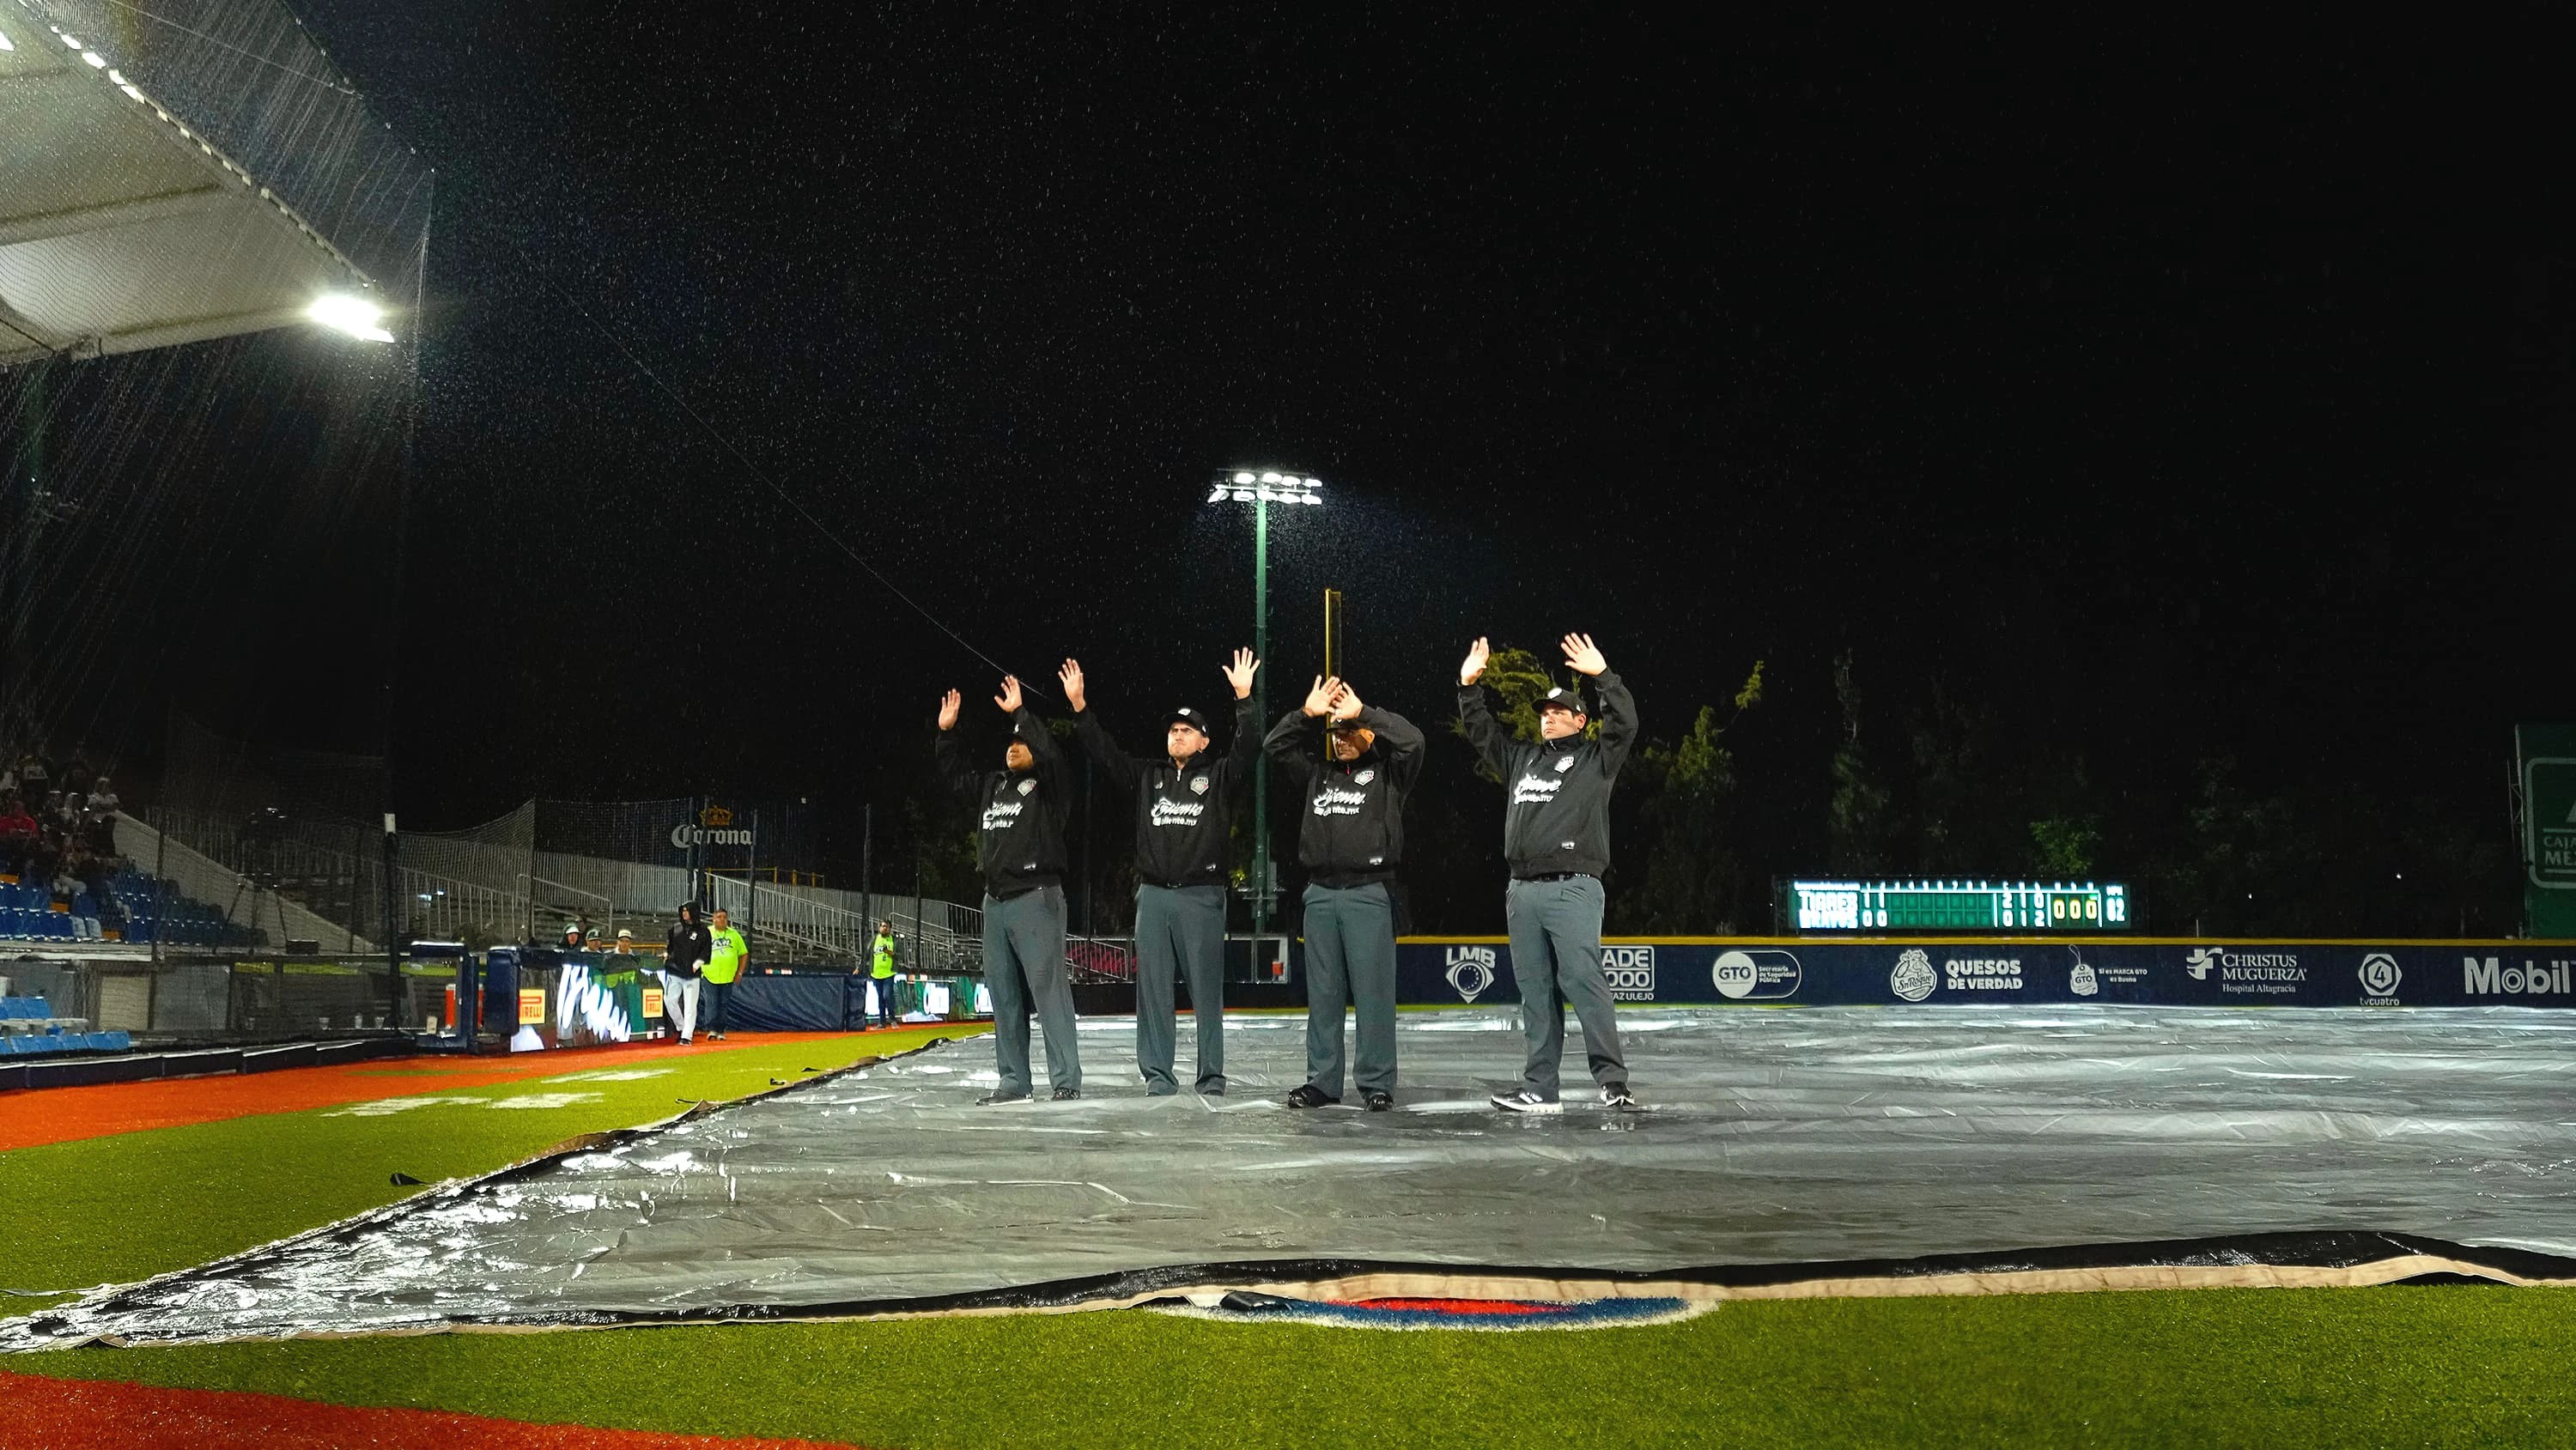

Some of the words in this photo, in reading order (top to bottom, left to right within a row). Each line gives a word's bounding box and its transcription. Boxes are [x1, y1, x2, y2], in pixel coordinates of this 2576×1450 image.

[671, 824, 752, 848] Corona
[1864, 893, 1870, 908] 1
[1879, 893, 1885, 908] 1
[2002, 893, 2013, 908] 2
[2021, 893, 2026, 908] 1
[2034, 893, 2044, 908] 0
[1862, 909, 1873, 927] 0
[1877, 909, 1887, 927] 0
[2002, 909, 2014, 927] 0
[2020, 909, 2027, 927] 1
[2034, 909, 2045, 927] 2
[2053, 900, 2065, 919] 0
[2069, 900, 2081, 919] 0
[2086, 900, 2097, 919] 0
[1446, 947, 1496, 969] LMB
[1601, 949, 1649, 968] ADE
[2222, 954, 2297, 967] CHRISTUS
[1718, 967, 1752, 980] GTO
[1946, 960, 2021, 978] QUESOS
[2222, 968, 2306, 980] MUGUERZA
[2373, 966, 2386, 984] 4
[2464, 957, 2570, 994] Mobil
[1606, 971, 1649, 987] 000
[1947, 979, 1965, 989] DE
[1966, 979, 2023, 989] VERDAD
[1613, 992, 1655, 1001] AZULEJO
[2222, 984, 2254, 994] Hospital
[2257, 984, 2296, 994] Altagracia
